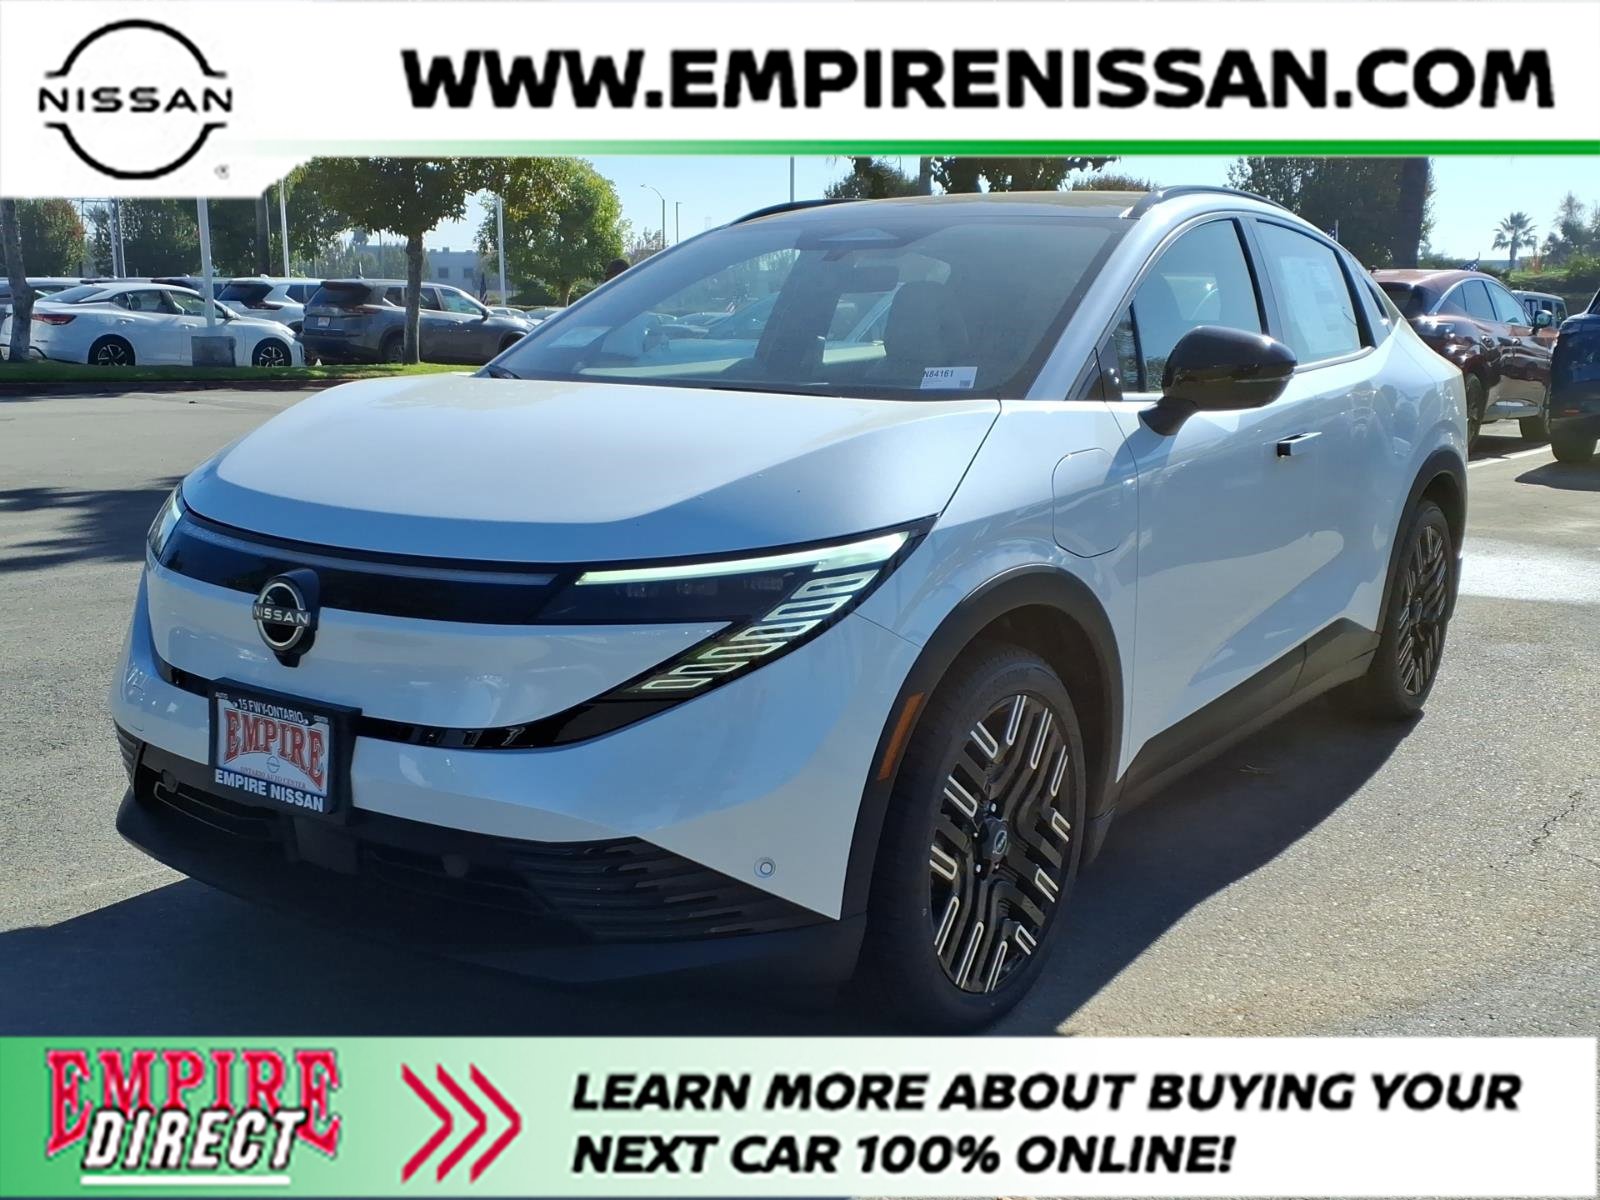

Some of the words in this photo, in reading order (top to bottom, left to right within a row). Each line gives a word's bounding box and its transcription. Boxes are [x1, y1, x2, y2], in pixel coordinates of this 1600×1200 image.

[254, 606, 309, 625] NISSAN
[238, 698, 248, 711] 15
[223, 708, 324, 792] EMPIRE
[215, 768, 267, 796] EMPIRE
[270, 784, 324, 813] NISSAN
